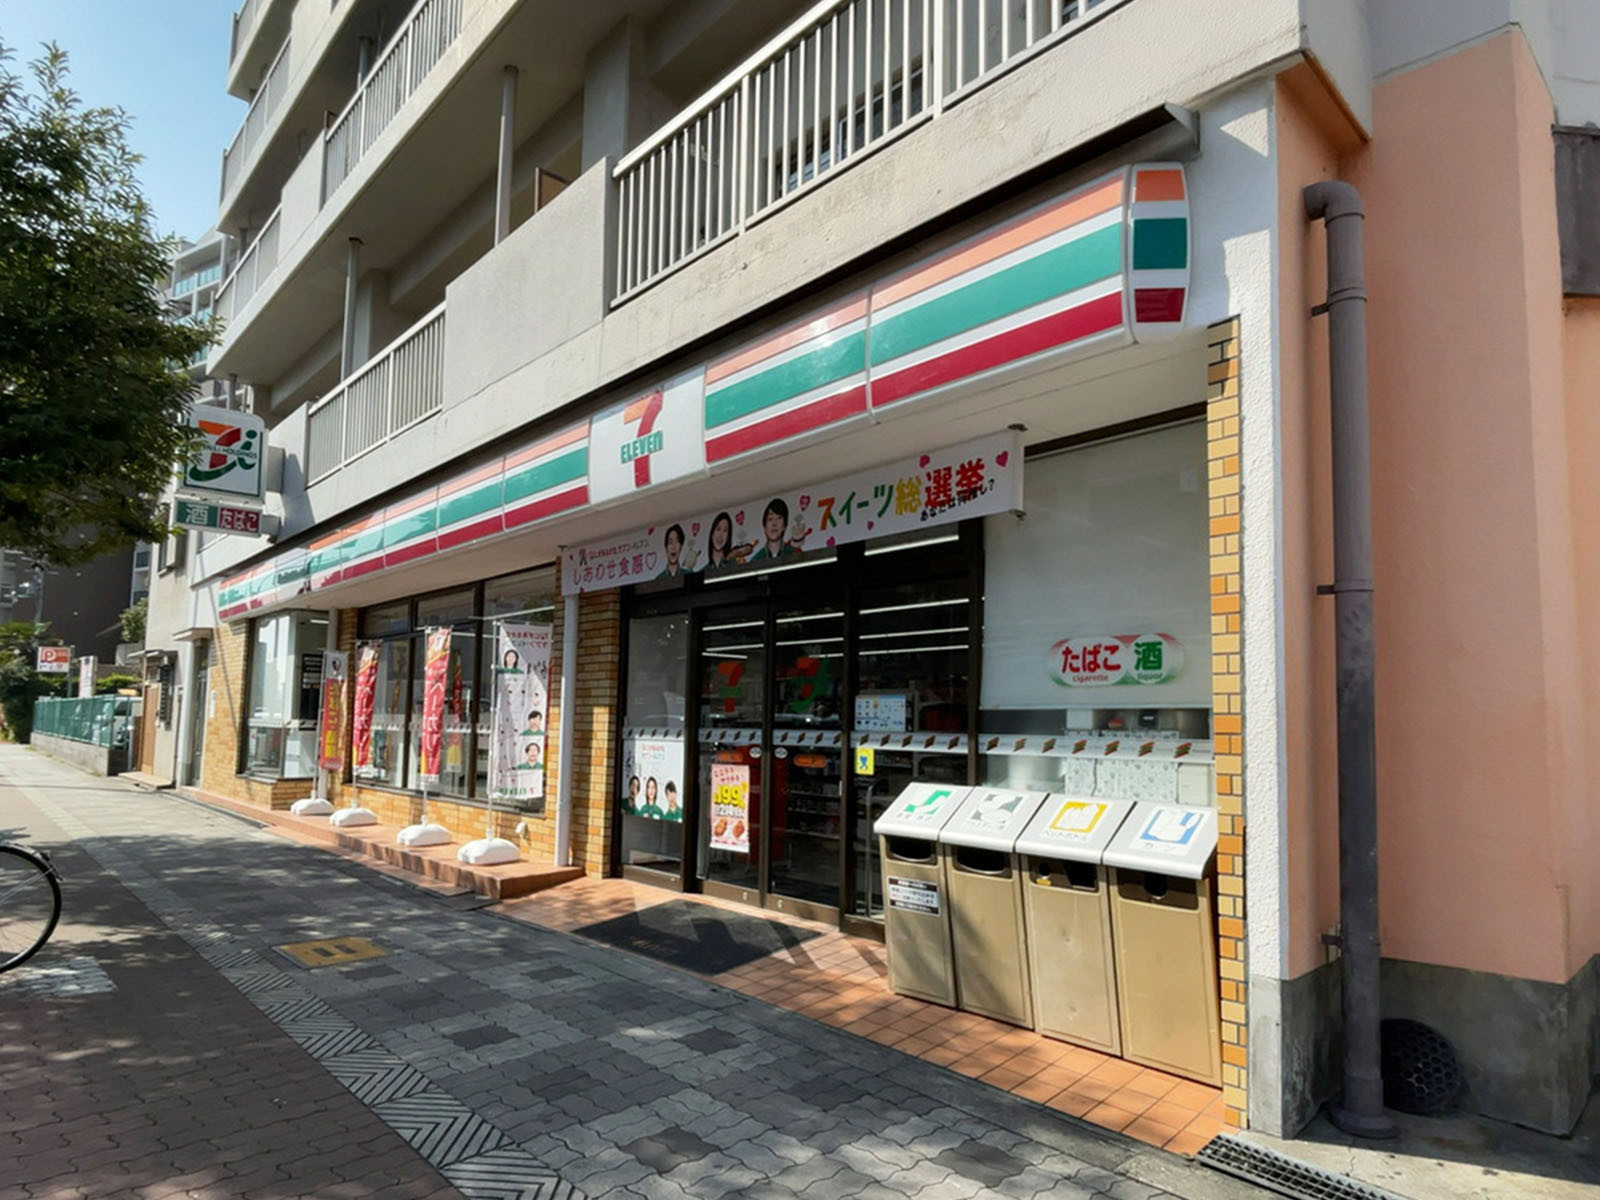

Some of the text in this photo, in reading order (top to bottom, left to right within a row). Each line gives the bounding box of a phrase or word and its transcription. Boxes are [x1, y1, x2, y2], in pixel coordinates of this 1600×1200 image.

[817, 458, 985, 531] スイーツ総選挙
[185, 503, 209, 525] 酒
[221, 509, 257, 531] たばこ
[1062, 644, 1121, 674] たばこ
[1134, 641, 1163, 671] 酒
